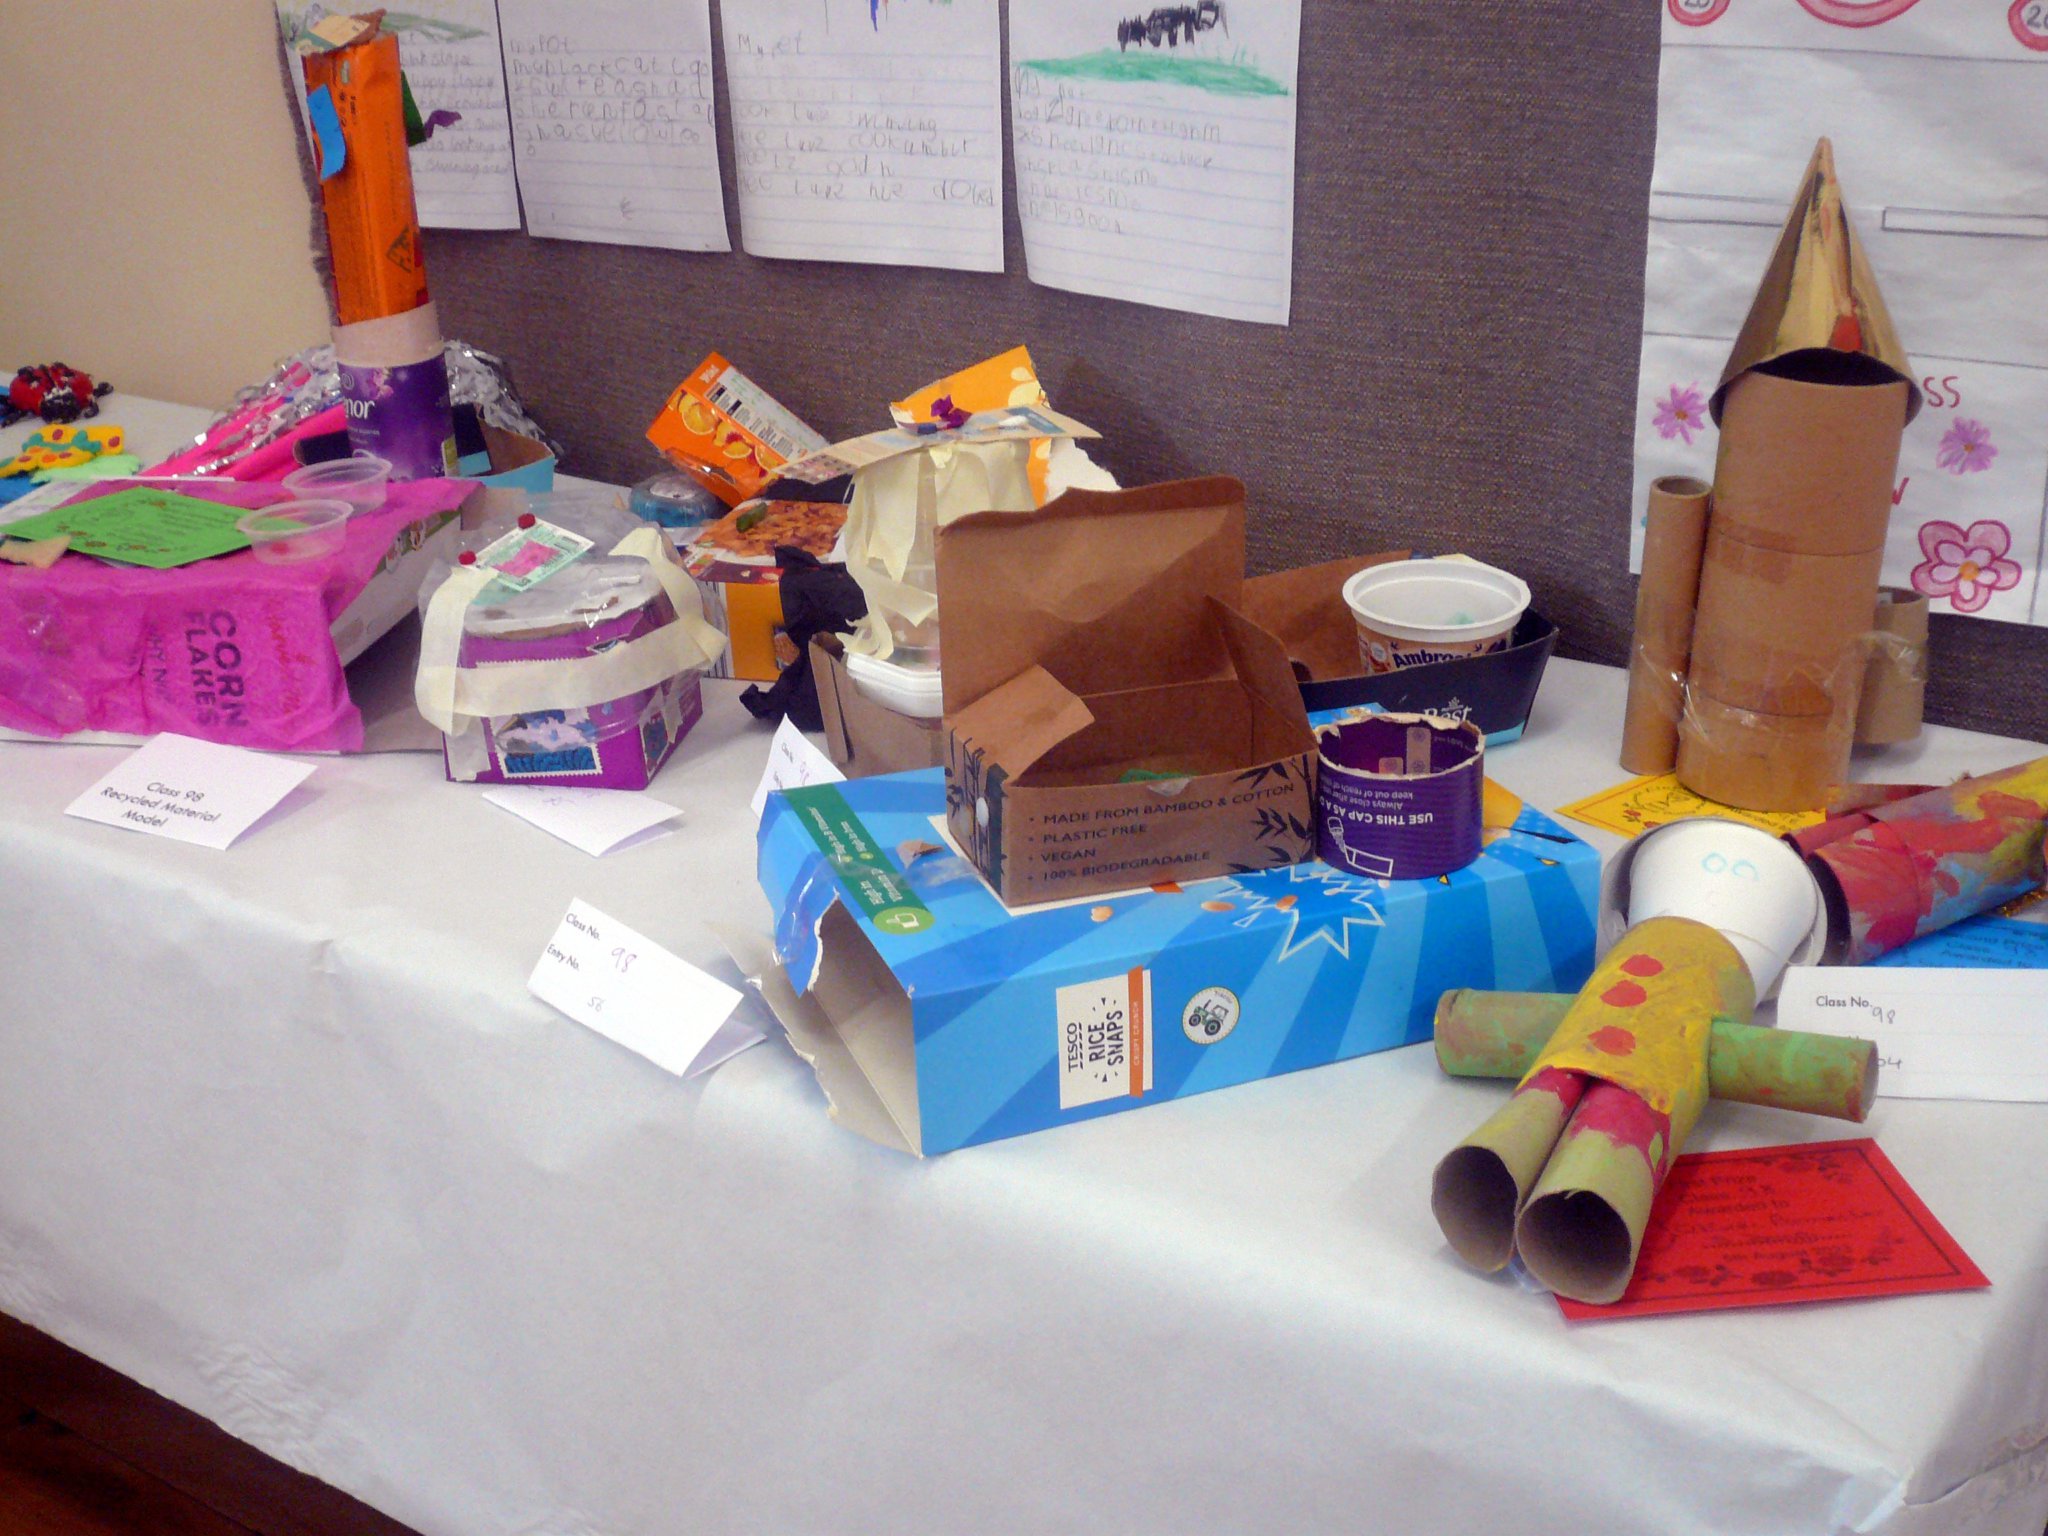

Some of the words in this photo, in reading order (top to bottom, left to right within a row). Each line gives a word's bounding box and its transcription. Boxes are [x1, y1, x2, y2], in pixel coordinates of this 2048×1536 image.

[210, 609, 249, 729] CORN
[1391, 648, 1473, 669] Ambro
[183, 610, 221, 730] FLAKES
[146, 782, 180, 797] Class
[184, 790, 204, 802] 98
[100, 786, 160, 809] Recycled
[161, 802, 221, 822] Material
[1043, 811, 1091, 825] MADE
[1094, 806, 1140, 820] FROM
[1143, 799, 1213, 815] BAMBOO
[1217, 797, 1228, 808] &
[1231, 783, 1295, 804] COTTON
[1333, 804, 1347, 818] AS
[121, 810, 168, 827] Model
[1347, 810, 1374, 824] CAP
[1376, 814, 1406, 826] THIS
[1408, 812, 1434, 825] USE
[1042, 829, 1107, 844] PLASTIC
[1111, 823, 1147, 836] FREE
[1040, 848, 1096, 863] VEGAN
[1043, 870, 1077, 881] 100%
[1081, 851, 1212, 877] BIODEGRADABLE
[565, 912, 587, 933] Class
[586, 925, 602, 942] No.
[545, 943, 566, 962] Entry
[610, 946, 639, 975] 98
[1815, 994, 1848, 1008] Class
[1850, 995, 1874, 1009] No.
[1871, 1006, 1897, 1025] 98
[1067, 1021, 1078, 1073] TESCO
[1088, 1021, 1106, 1062] RICE
[1106, 1009, 1125, 1067] SNAPS
